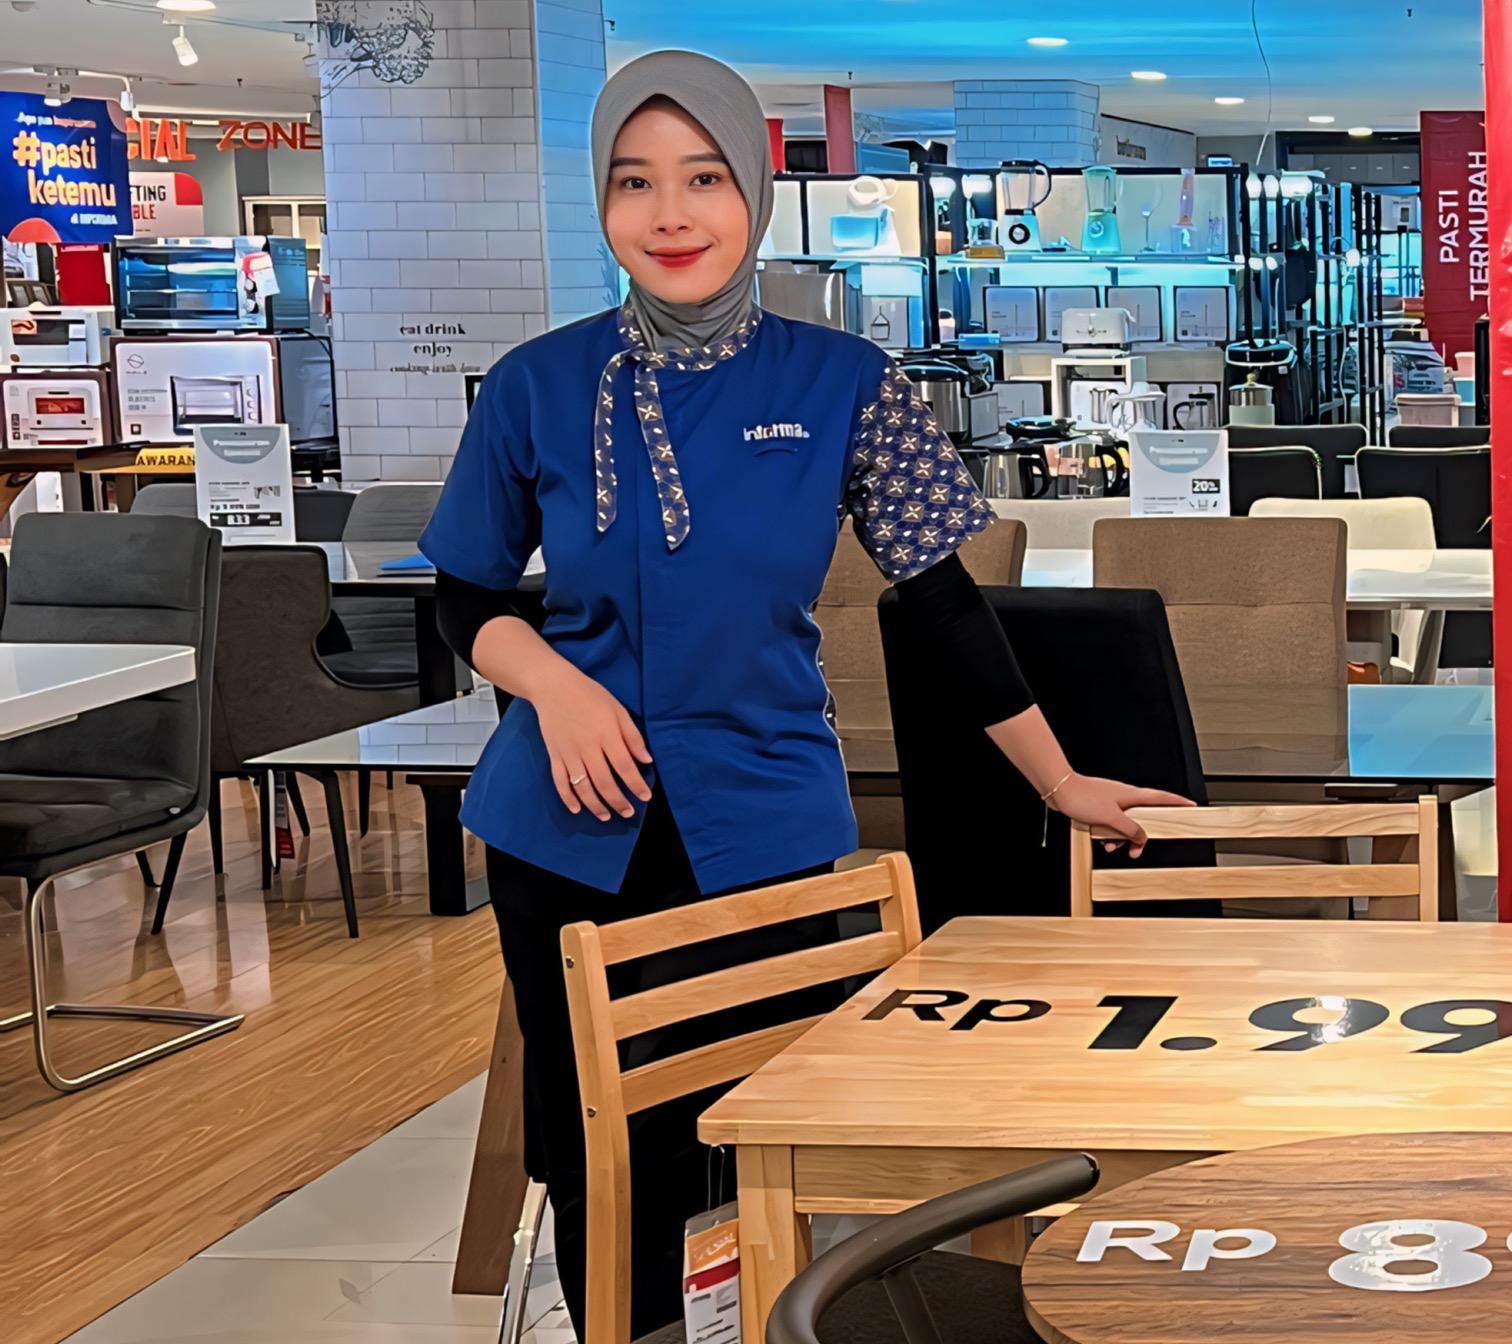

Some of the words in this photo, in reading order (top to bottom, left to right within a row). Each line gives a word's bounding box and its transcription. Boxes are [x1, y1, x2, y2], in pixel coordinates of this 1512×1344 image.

[12, 130, 97, 176] #pasti
[215, 119, 322, 151] ZONE
[27, 168, 117, 207] ketemu
[1438, 189, 1460, 263] PASTI
[1468, 151, 1490, 301] TERMURAH
[413, 341, 452, 357] enjoy
[425, 323, 466, 335] drink
[861, 989, 1052, 1031] Rp
[1076, 1220, 1278, 1272] Rp
